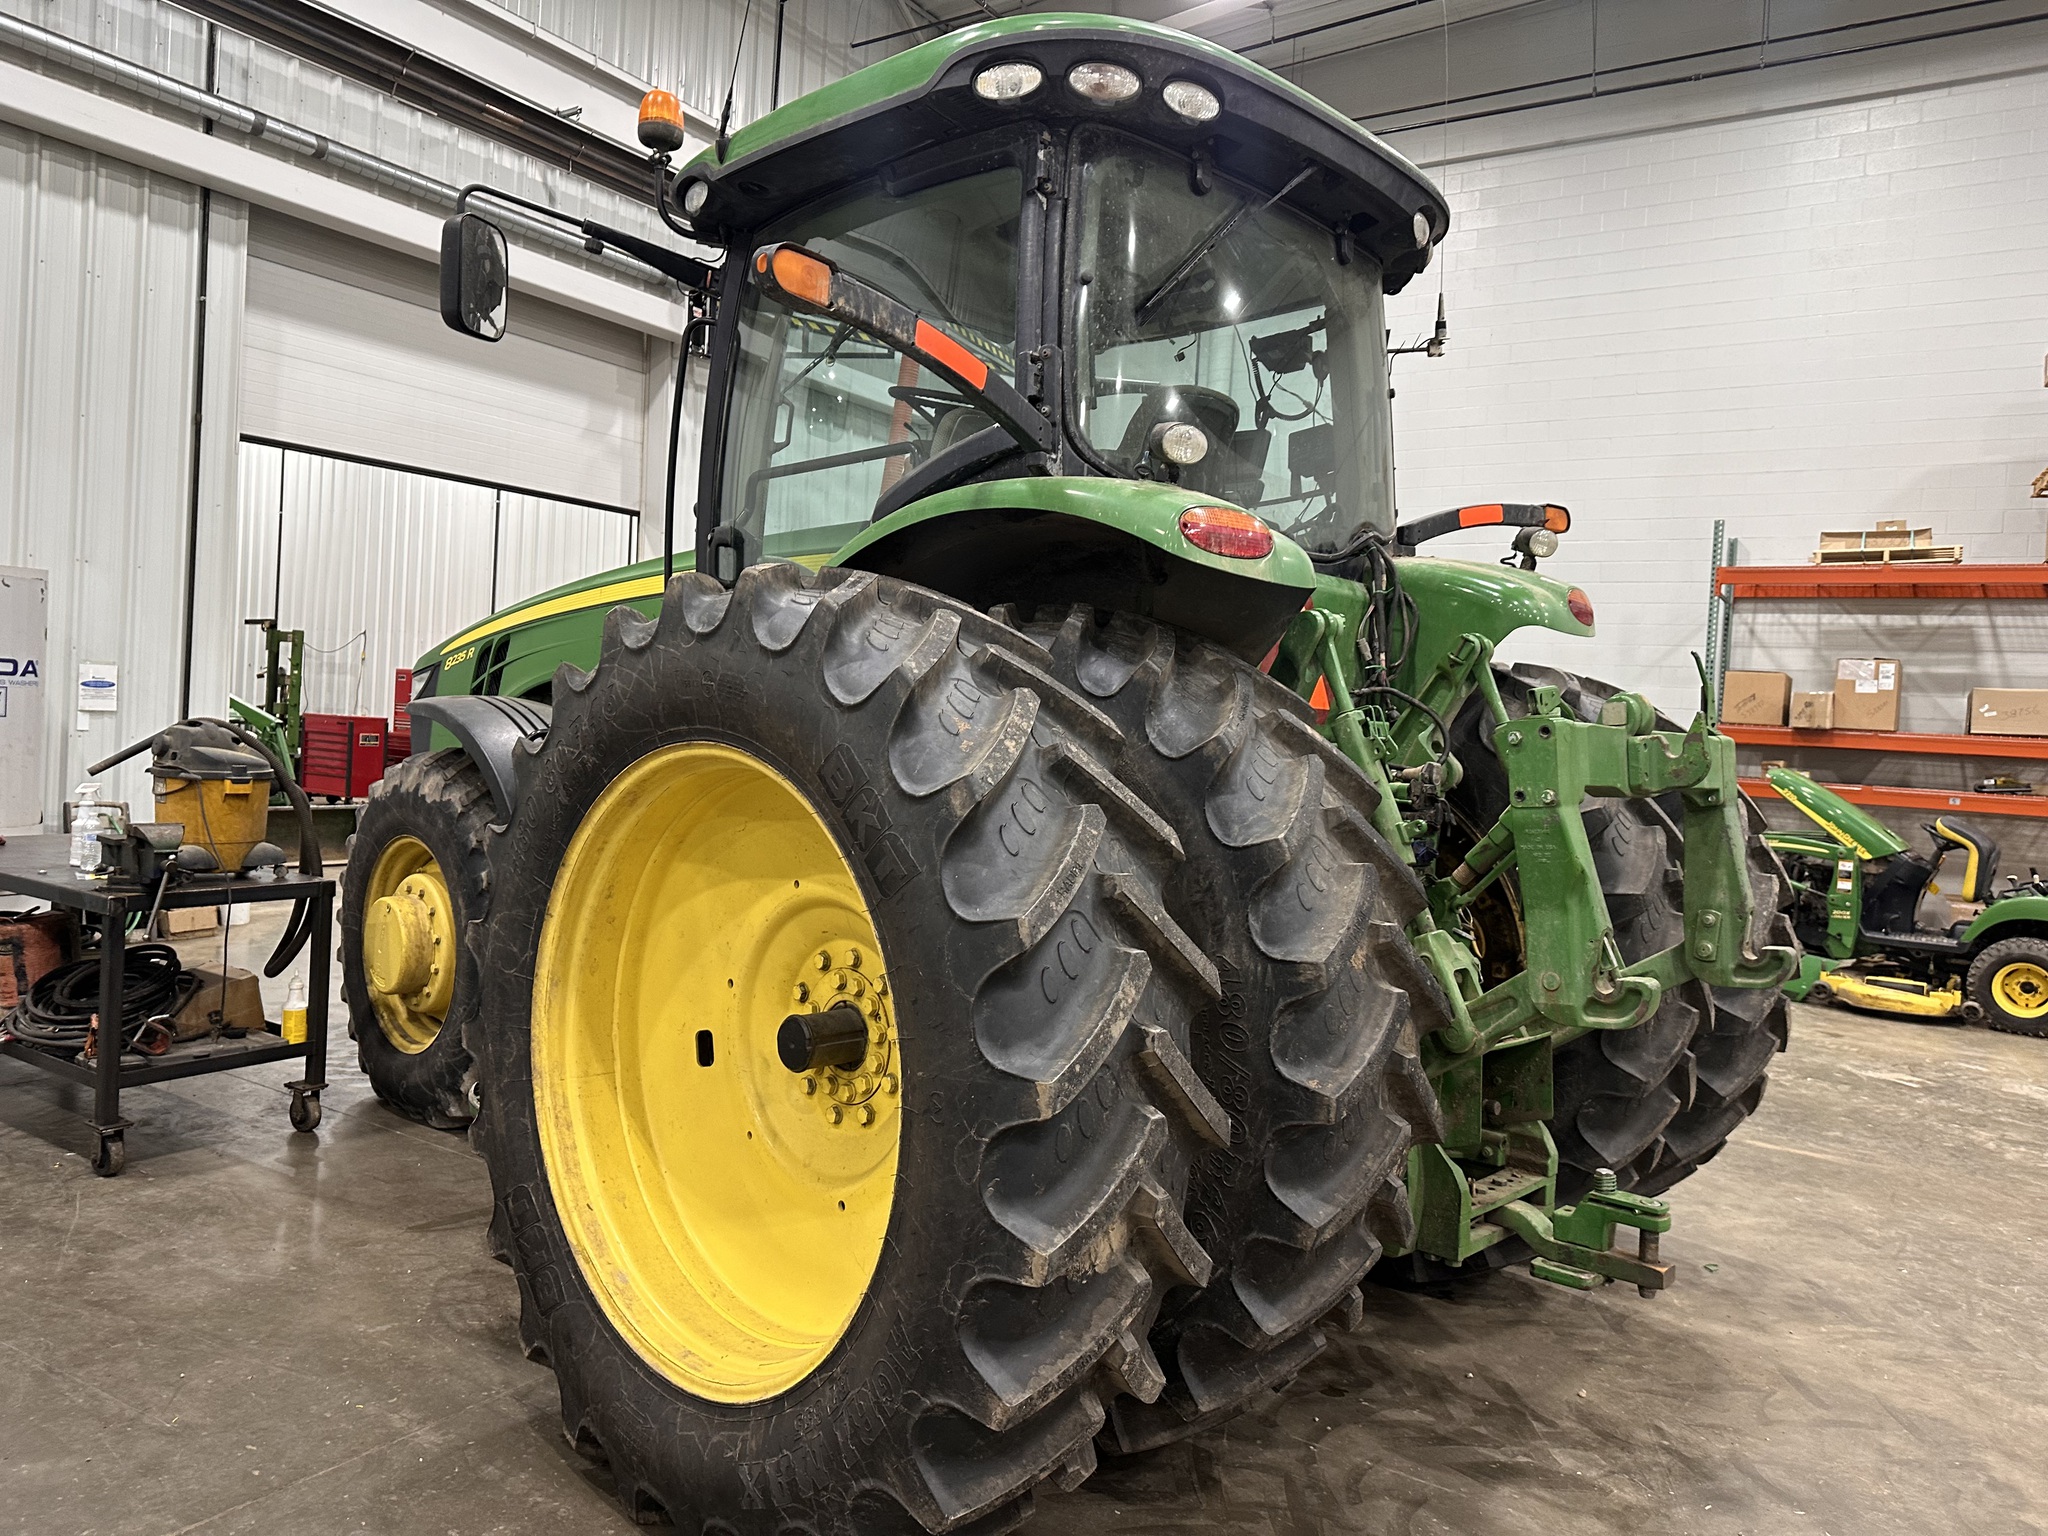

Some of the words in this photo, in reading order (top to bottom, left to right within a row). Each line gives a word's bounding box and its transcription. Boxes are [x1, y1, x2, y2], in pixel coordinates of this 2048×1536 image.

[444, 650, 467, 670] 8235
[467, 647, 475, 660] R
[817, 743, 921, 899] BKT
